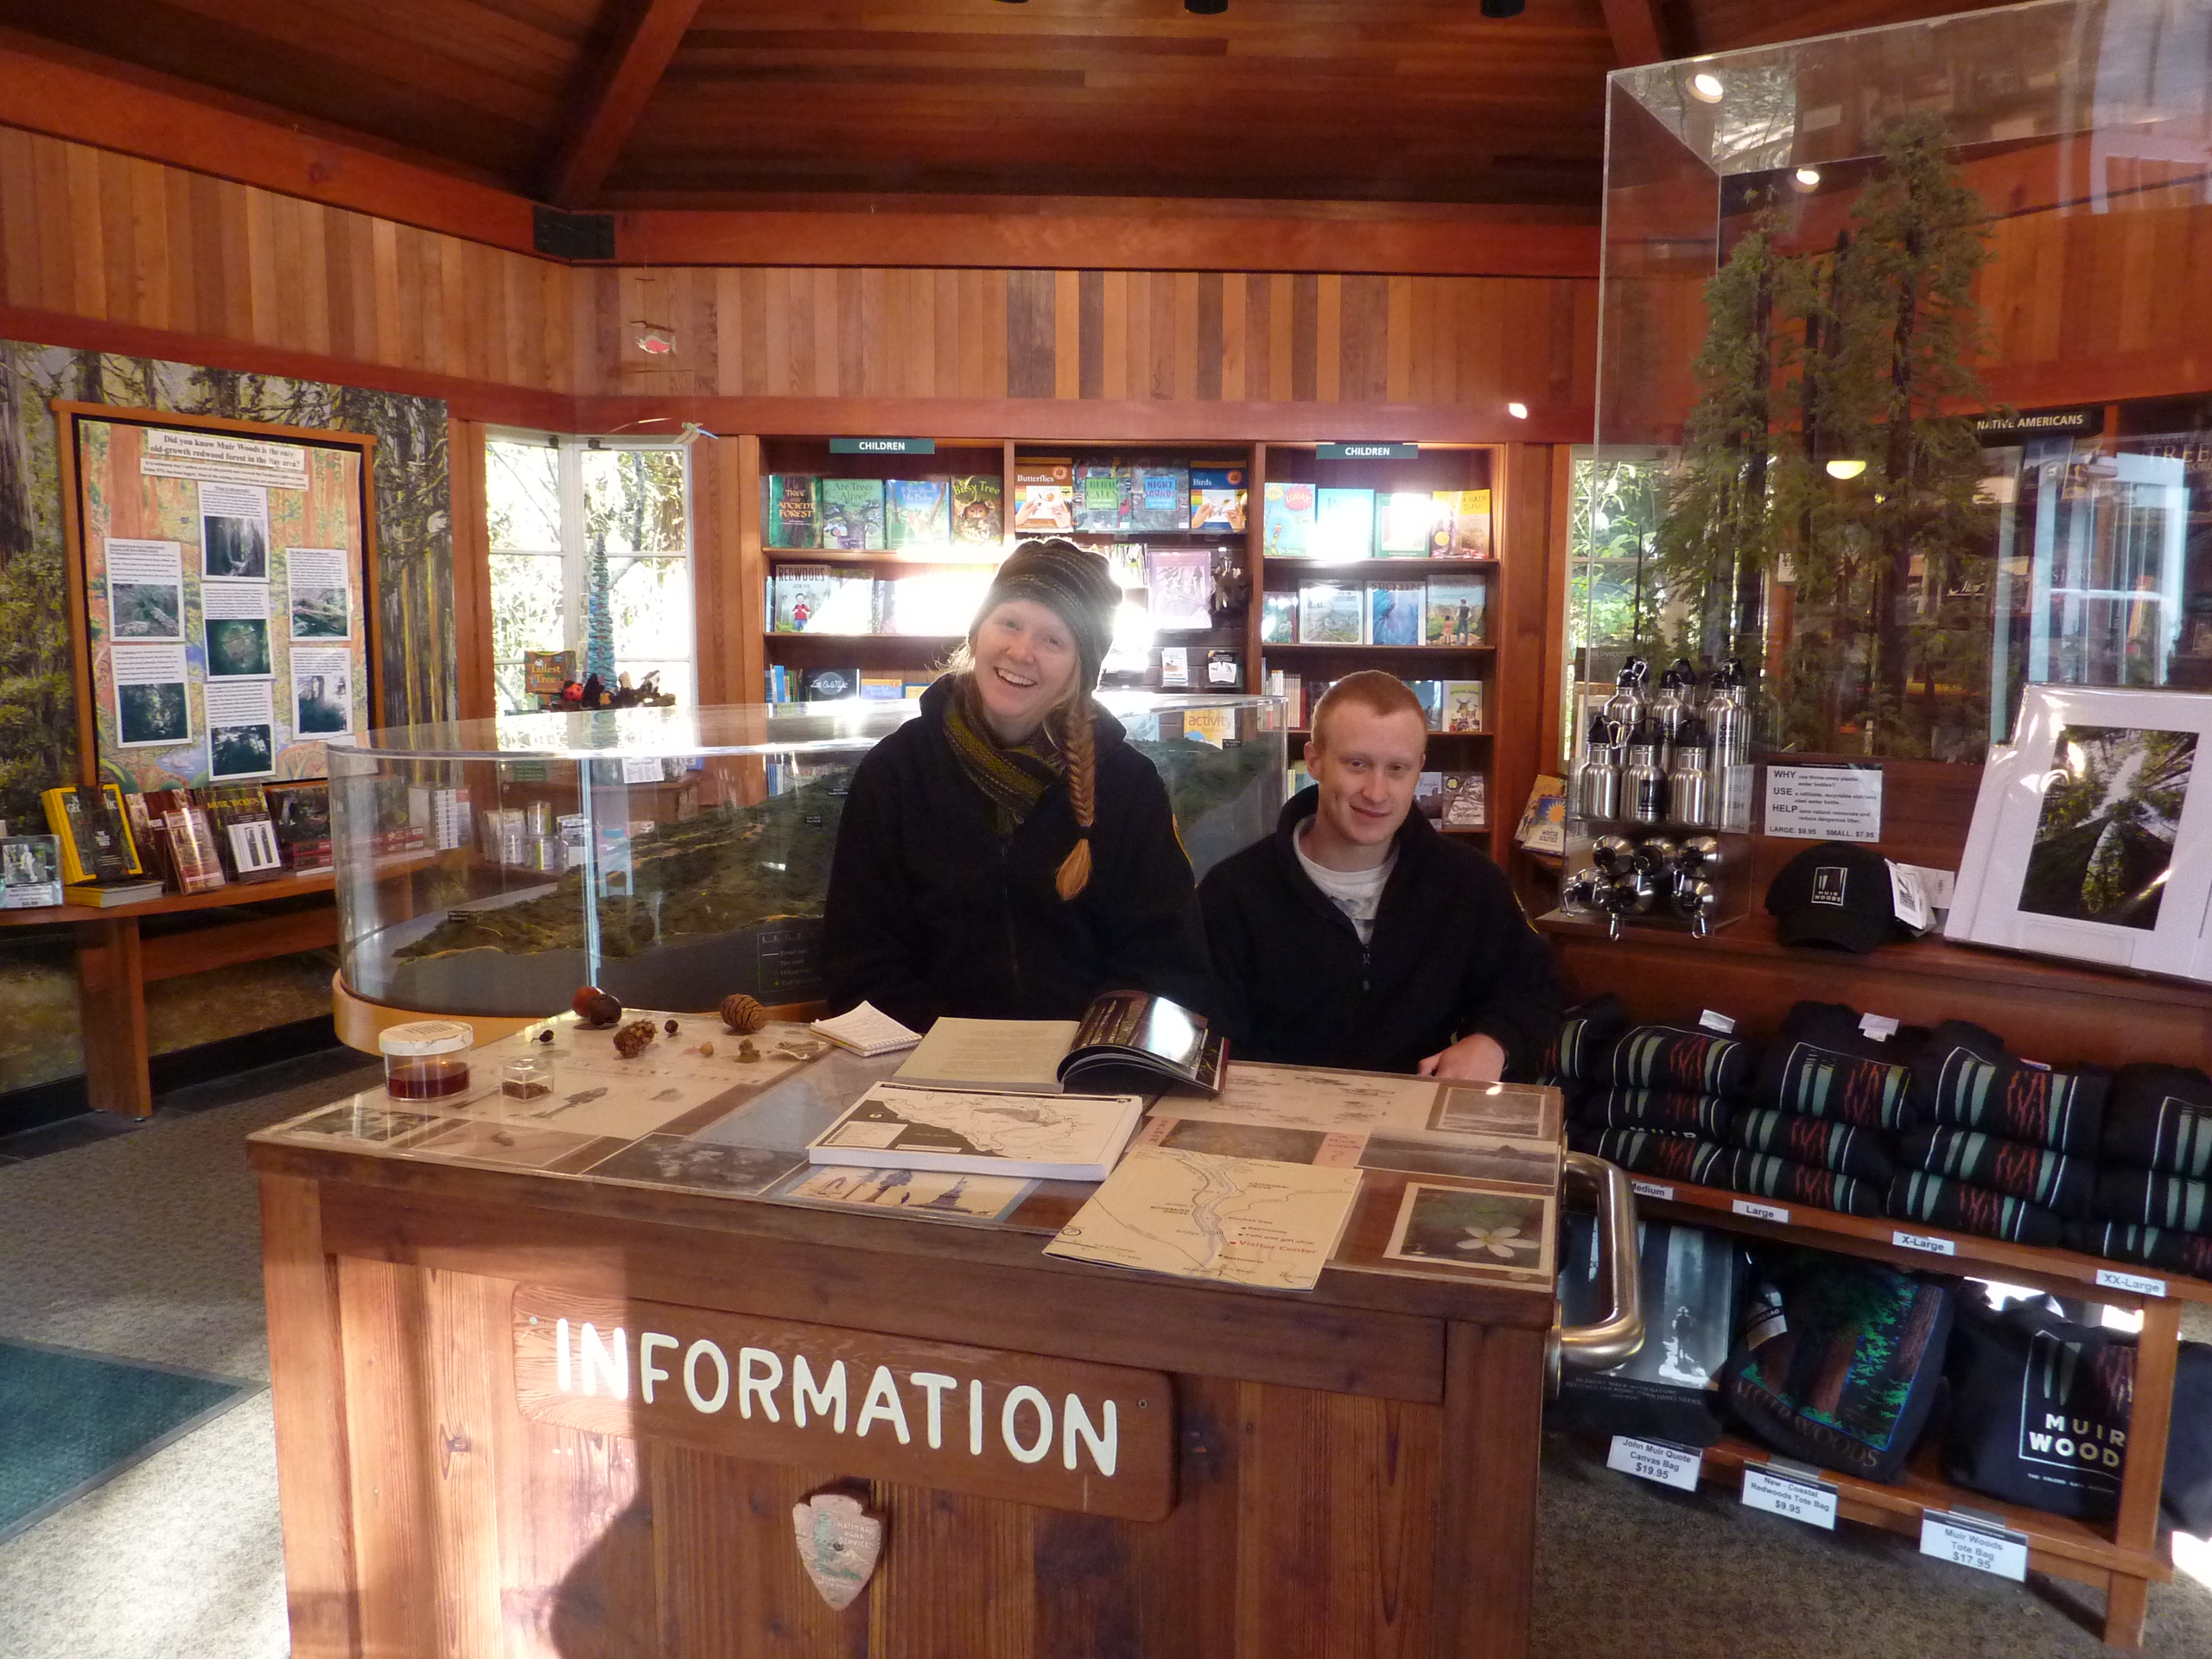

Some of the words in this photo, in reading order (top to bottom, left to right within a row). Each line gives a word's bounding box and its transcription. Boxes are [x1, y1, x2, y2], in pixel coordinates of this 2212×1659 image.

[2018, 415, 2083, 428] AMERICANS
[164, 435, 177, 444] Did
[179, 438, 193, 447] you
[194, 439, 214, 448] know
[217, 442, 235, 450] Muir
[238, 443, 260, 453] Woods
[268, 448, 278, 456] the
[859, 442, 906, 450] CHILDREN
[1344, 447, 1390, 456] CHILDREN
[150, 445, 191, 456] old-growth
[193, 448, 224, 460] redwood
[226, 452, 245, 461] forest
[257, 455, 267, 464] the
[833, 482, 850, 491] Are
[852, 481, 873, 491] Trees
[953, 484, 976, 495] Busy
[979, 480, 1001, 494] Tree
[1192, 478, 1212, 486] Birds
[841, 492, 868, 500] Alive?
[1144, 489, 1176, 499] SOUNDS
[1285, 492, 1311, 504] LORAX
[779, 567, 825, 582] REDWOODS
[530, 664, 561, 674] Tallest
[536, 673, 556, 683] Tree
[1188, 713, 1233, 728] activity
[1774, 770, 1796, 779] WHY
[1773, 787, 1793, 796] USE
[1772, 804, 1798, 813] HELP
[1746, 1205, 1774, 1218] Large
[1239, 1240, 1276, 1249] Visitor
[1902, 1236, 1944, 1251] X-Large
[2104, 1274, 2159, 1293] XX-Large
[556, 1318, 1117, 1477] INFORMATION
[2045, 1413, 2126, 1447] MUIR
[1796, 1414, 1880, 1467] WOODS
[1623, 1439, 1643, 1449] John
[1645, 1445, 1664, 1456] Muir
[1665, 1450, 1691, 1464] Quote
[2029, 1431, 2120, 1467] WOOD
[1630, 1451, 1661, 1465] Canvas
[1662, 1460, 1680, 1472] Bag
[1635, 1462, 1669, 1479] $19.95
[1764, 1477, 1781, 1487] New
[1788, 1484, 1818, 1497] Coastal
[1751, 1482, 1792, 1500] Redwoods
[1794, 1494, 1811, 1505] Tote
[1813, 1500, 1830, 1512] Bag
[1775, 1499, 1801, 1514] $9.95
[837, 1522, 874, 1535] NATIONAL
[840, 1537, 869, 1548] SERVICE
[1944, 1528, 1967, 1540] Muir
[1969, 1535, 2003, 1551] Woods
[1951, 1541, 1972, 1554] Tote
[1975, 1548, 1994, 1561] Bag
[1952, 1551, 1991, 1569] $17.95
